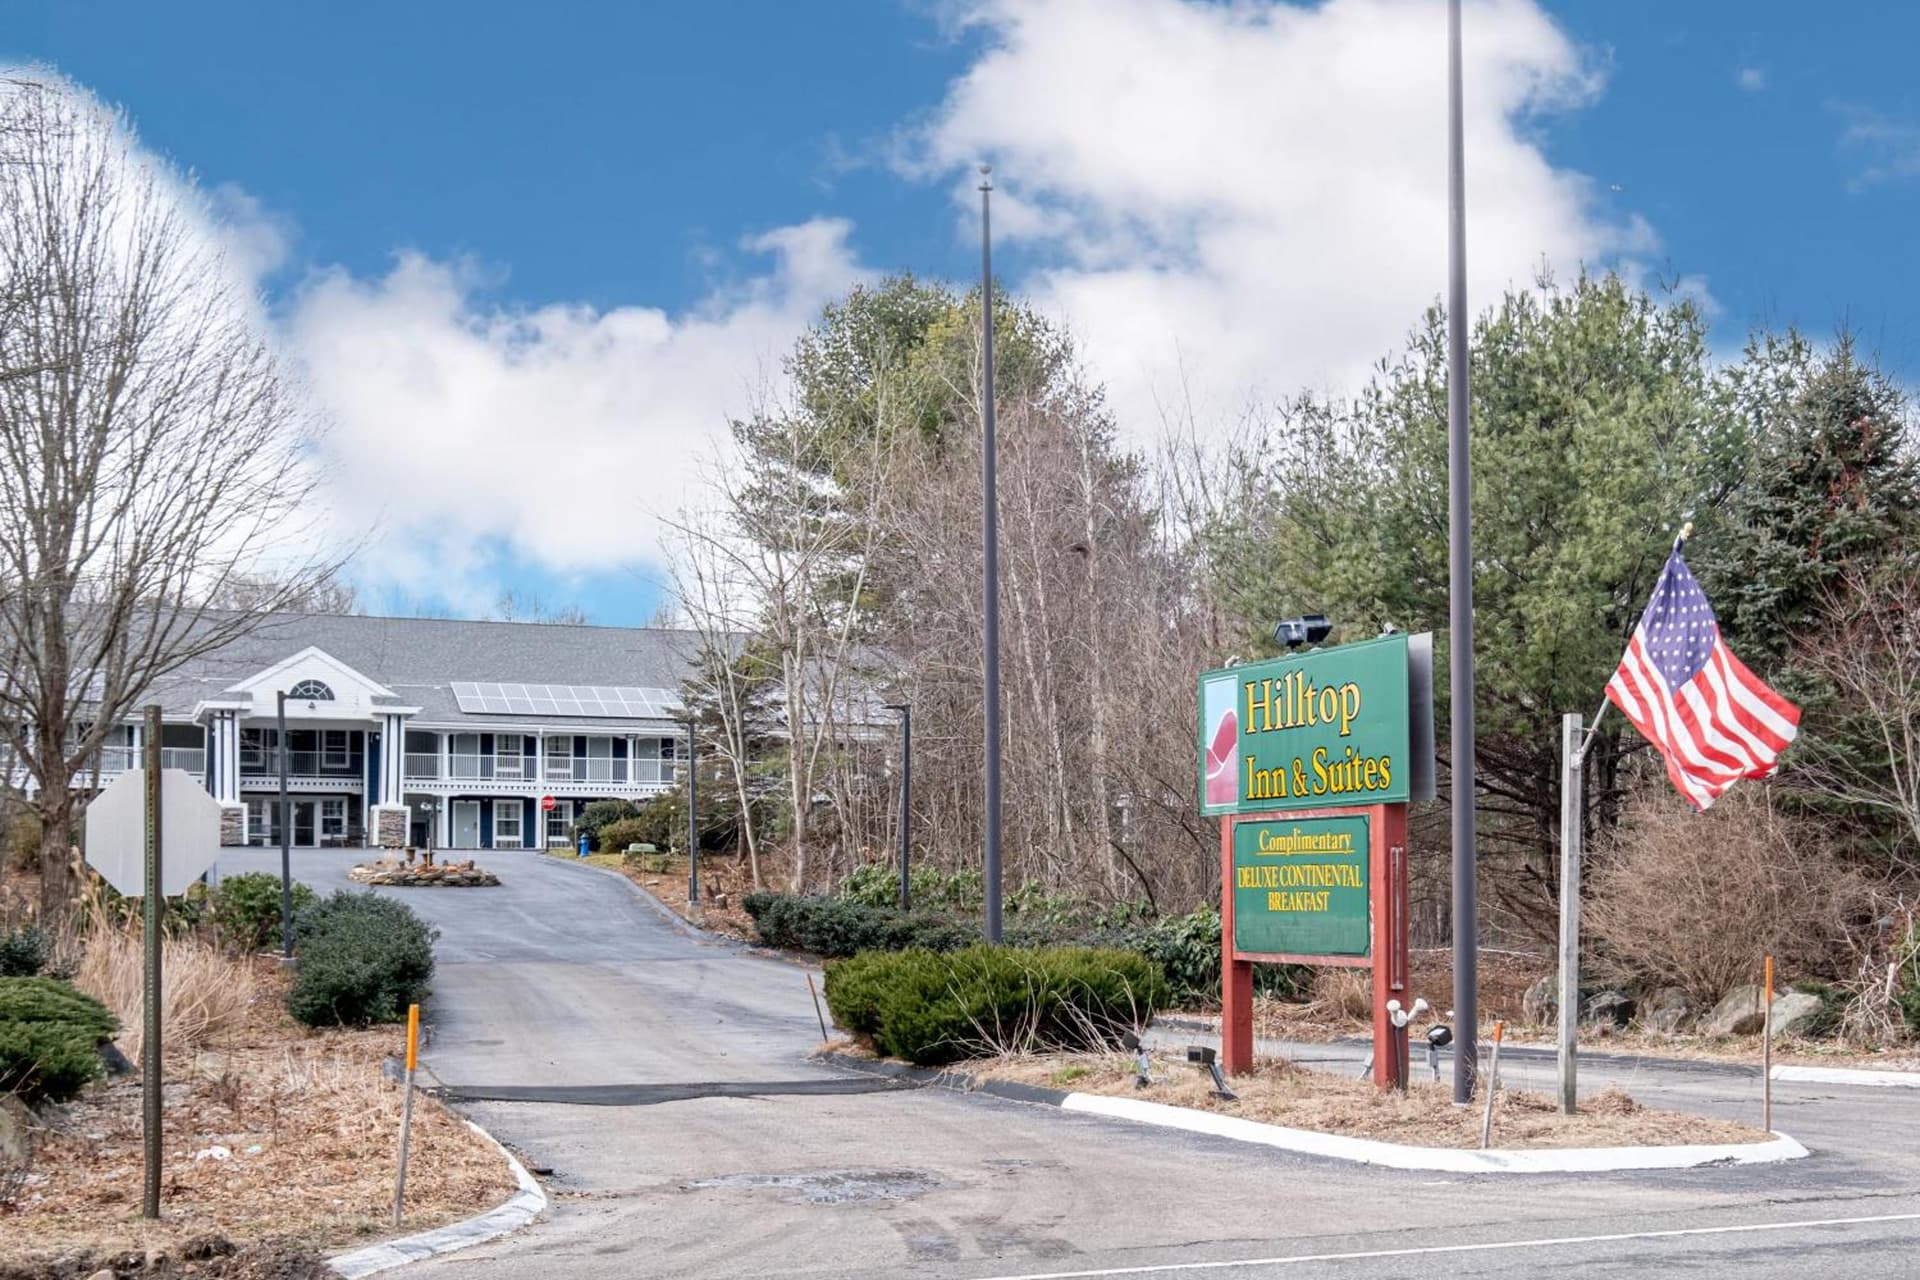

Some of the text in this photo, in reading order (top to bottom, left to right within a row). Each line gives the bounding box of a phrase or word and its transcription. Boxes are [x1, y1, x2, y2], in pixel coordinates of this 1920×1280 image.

[1245, 668, 1361, 737] Hilltop
[1246, 746, 1391, 800] Inn & Suites
[1258, 828, 1352, 856] Complimentary
[1238, 864, 1363, 888] DELUXE CONTINENTAL
[1268, 891, 1330, 912] BREAKFAST
